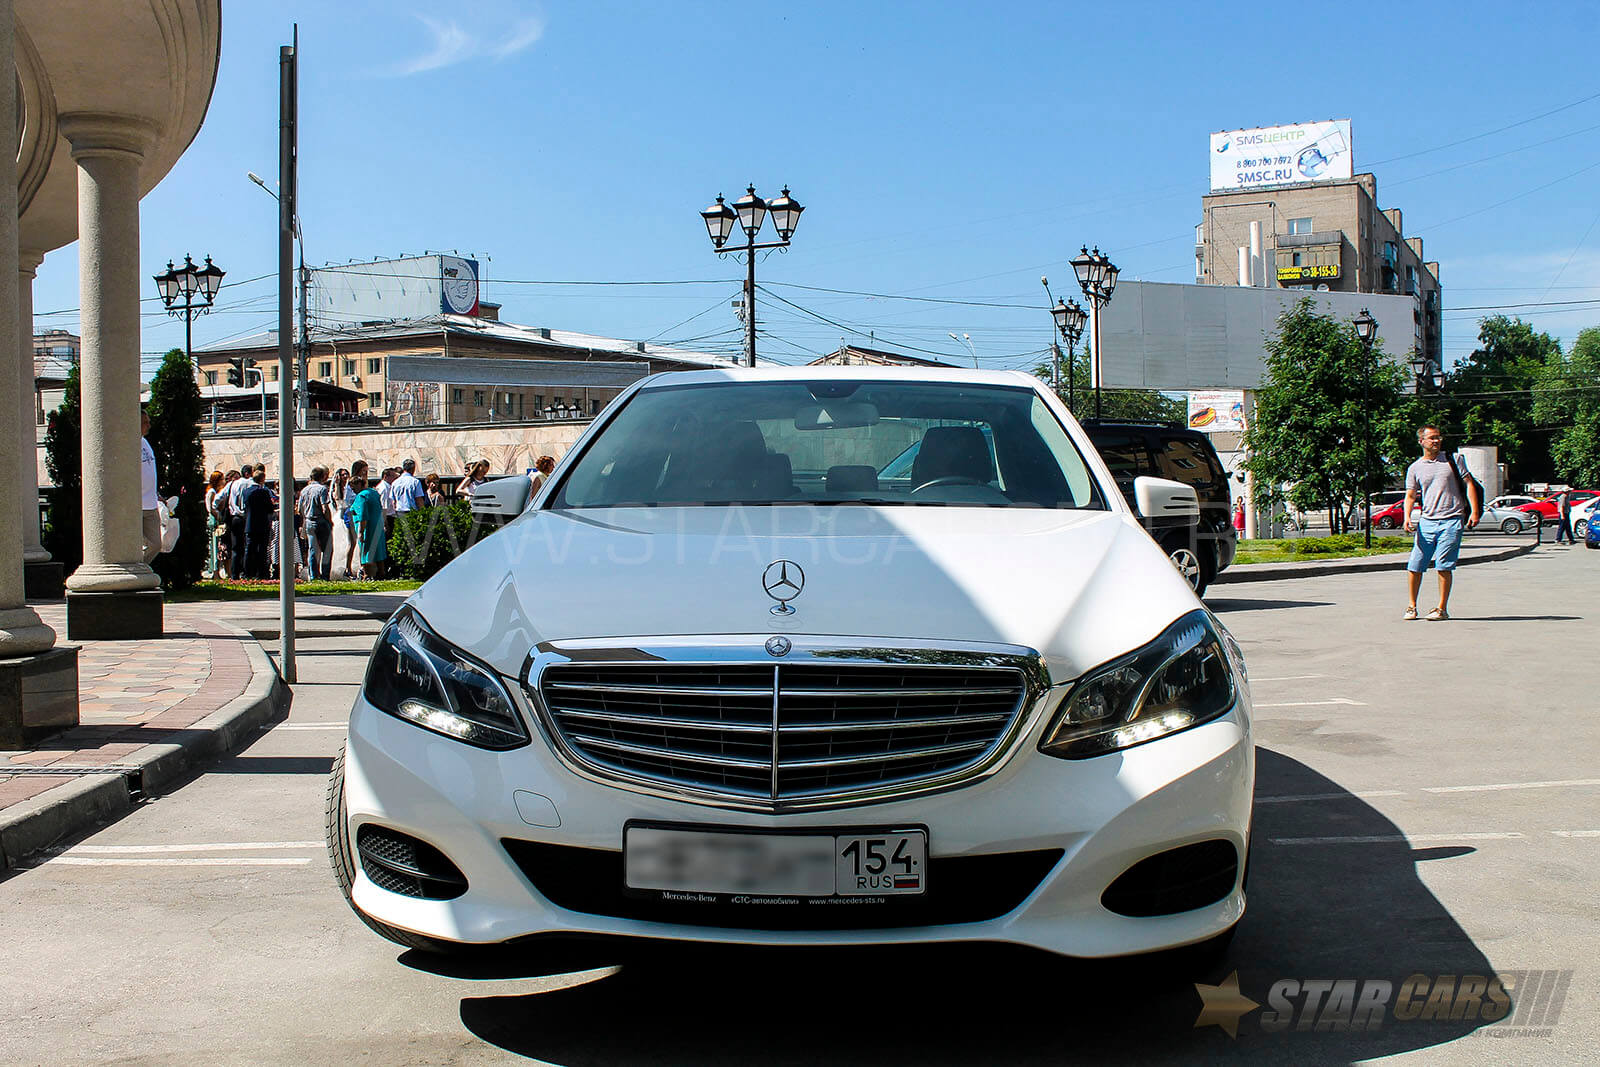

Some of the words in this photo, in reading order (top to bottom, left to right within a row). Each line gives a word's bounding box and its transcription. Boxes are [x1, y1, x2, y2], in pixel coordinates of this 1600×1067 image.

[1236, 168, 1293, 183] SMSC.RU
[857, 876, 892, 888] RUS
[662, 892, 716, 902] Mercedes-Benz
